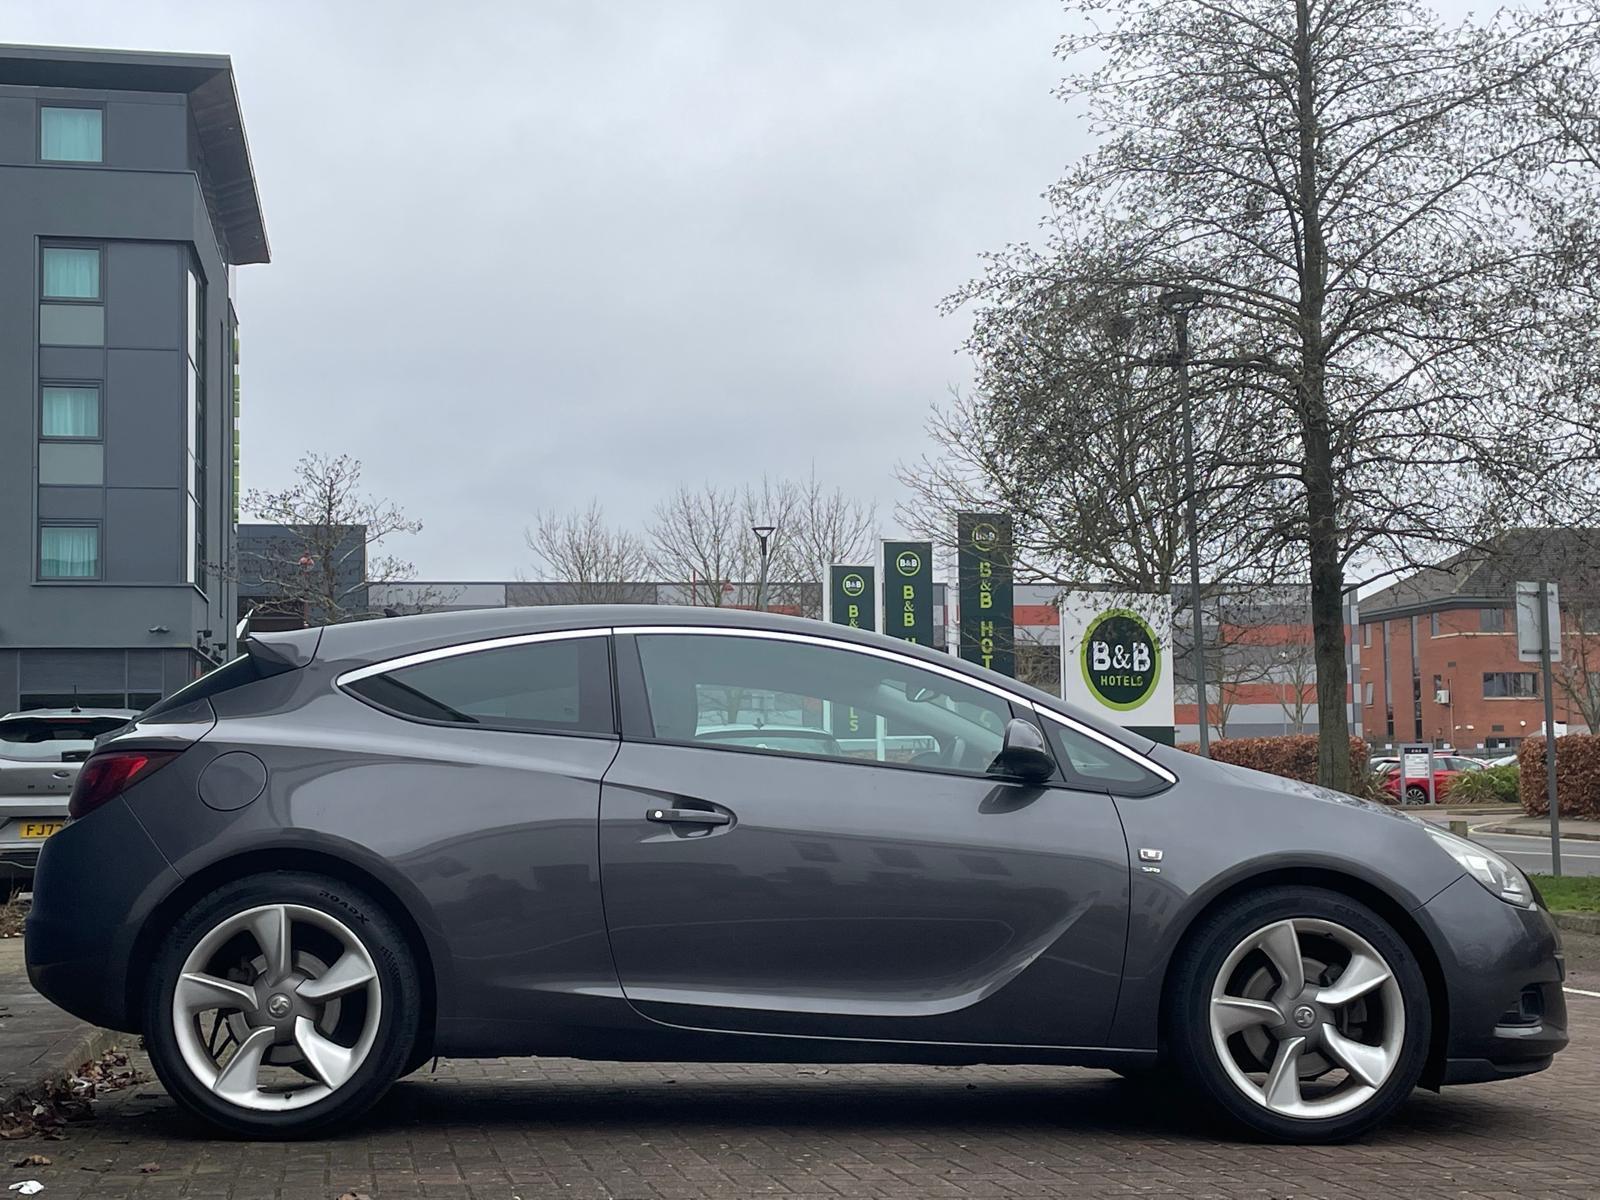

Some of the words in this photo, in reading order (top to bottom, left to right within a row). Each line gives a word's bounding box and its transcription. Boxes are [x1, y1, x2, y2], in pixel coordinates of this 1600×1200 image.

[900, 559, 917, 567] B&B
[845, 580, 862, 588] B&B
[903, 585, 915, 627] B&B
[1092, 641, 1151, 672] B&B
[1100, 675, 1144, 686] HOTELS
